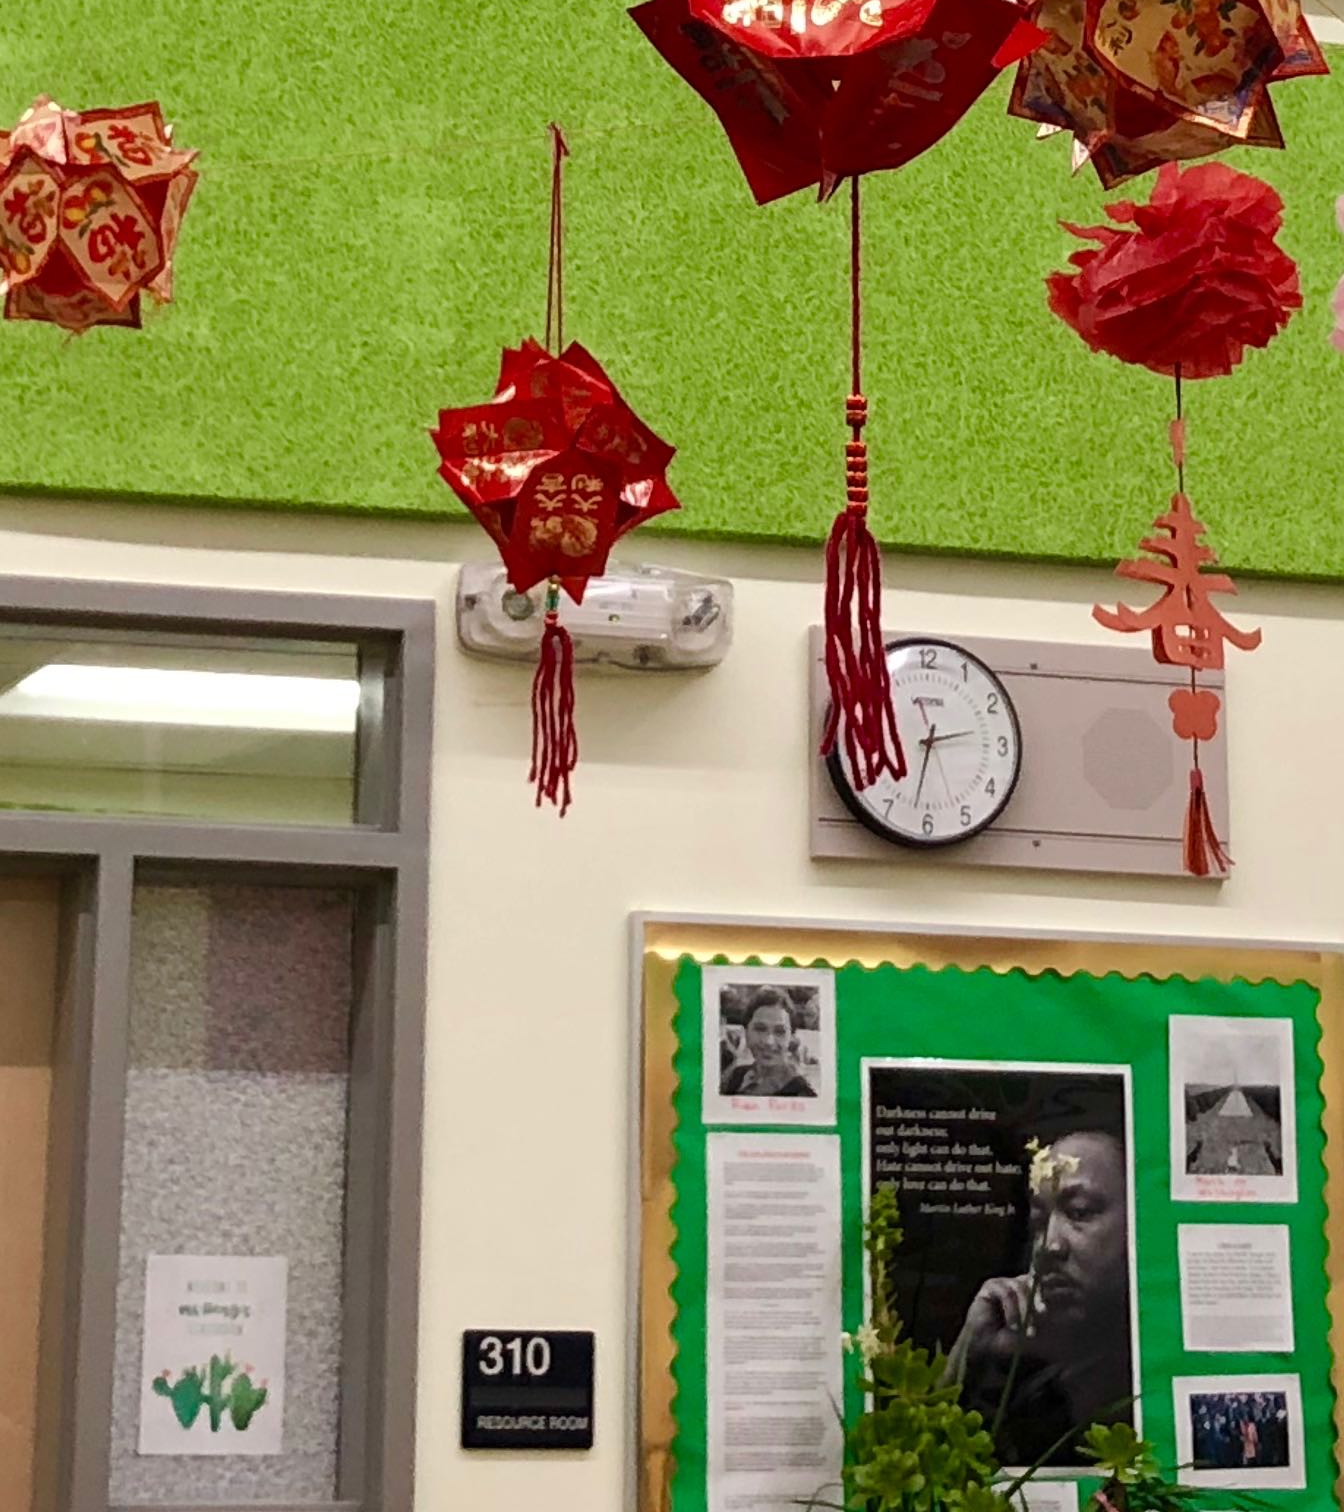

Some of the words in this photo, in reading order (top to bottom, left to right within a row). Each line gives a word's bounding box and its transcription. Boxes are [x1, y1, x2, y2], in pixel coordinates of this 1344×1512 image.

[919, 648, 938, 670] 12
[961, 661, 968, 682] 1
[987, 692, 998, 714] 2
[998, 736, 1009, 757] 3
[985, 777, 996, 798] 4
[882, 799, 895, 819] 7
[960, 805, 972, 826] 5
[922, 814, 934, 835] 6
[876, 1105, 927, 1119] Darkness
[929, 1109, 966, 1120] cannot
[968, 1107, 997, 1120] drive
[875, 1126, 894, 1136] out
[875, 1141, 900, 1156] only
[902, 1141, 928, 1157] light
[930, 1145, 950, 1155] can
[951, 1142, 967, 1155] do
[876, 1158, 903, 1172] Hate
[905, 1161, 943, 1172] cannot
[944, 1160, 973, 1173] drive
[974, 1163, 993, 1173] out
[902, 1177, 926, 1190] love
[928, 1180, 948, 1191] can
[949, 1178, 965, 1191] do
[920, 1201, 951, 1214] Martin
[953, 1202, 983, 1215] Luther
[984, 1203, 1006, 1217] King
[479, 1336, 551, 1376] 310
[477, 1415, 546, 1430] RESOURCE
[549, 1416, 589, 1431] ROOM
